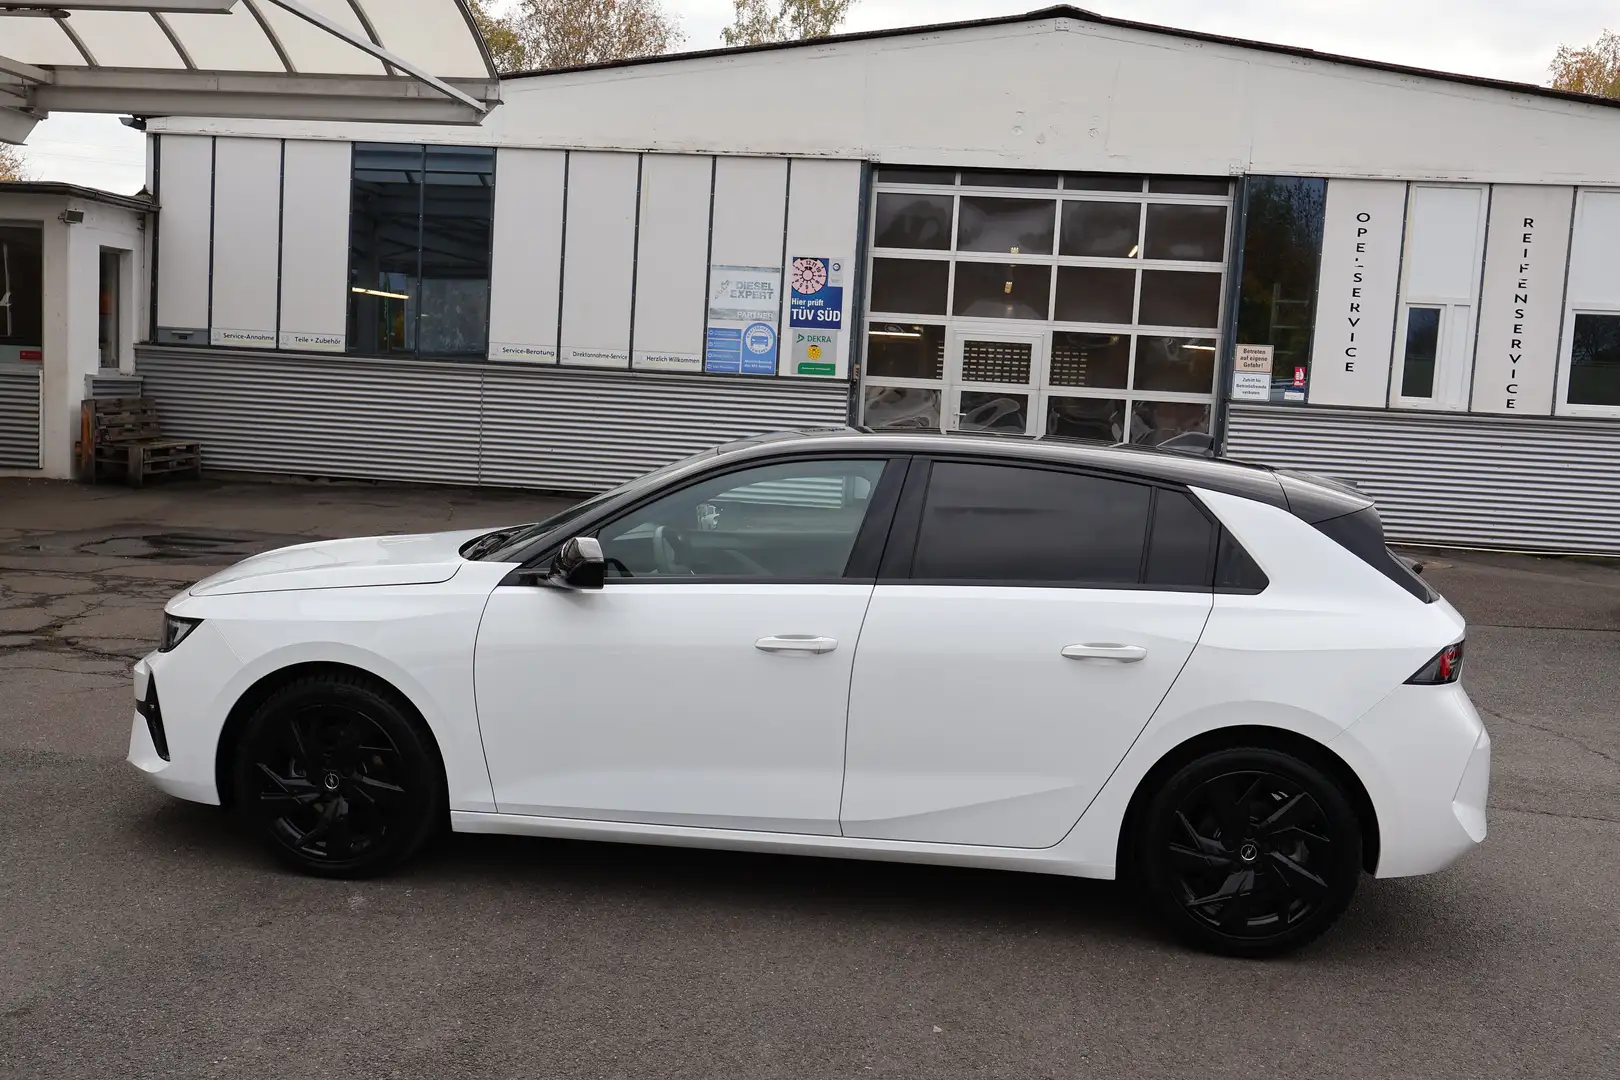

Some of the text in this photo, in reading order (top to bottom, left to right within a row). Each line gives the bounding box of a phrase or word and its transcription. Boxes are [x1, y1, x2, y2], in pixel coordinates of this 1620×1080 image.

[730, 290, 774, 300] EXPERT
[807, 299, 824, 307] prüft
[737, 311, 773, 320] PARTNER
[792, 306, 841, 322] TÜV SÜD
[1506, 218, 1534, 409] REIFENSERVICE
[223, 333, 275, 341] Service-Annahme
[807, 335, 832, 343] DEKRA
[502, 347, 555, 357] Service-Beratung
[573, 351, 628, 360] Direktannahme-Service
[646, 355, 700, 364] Herzlich Willkommen
